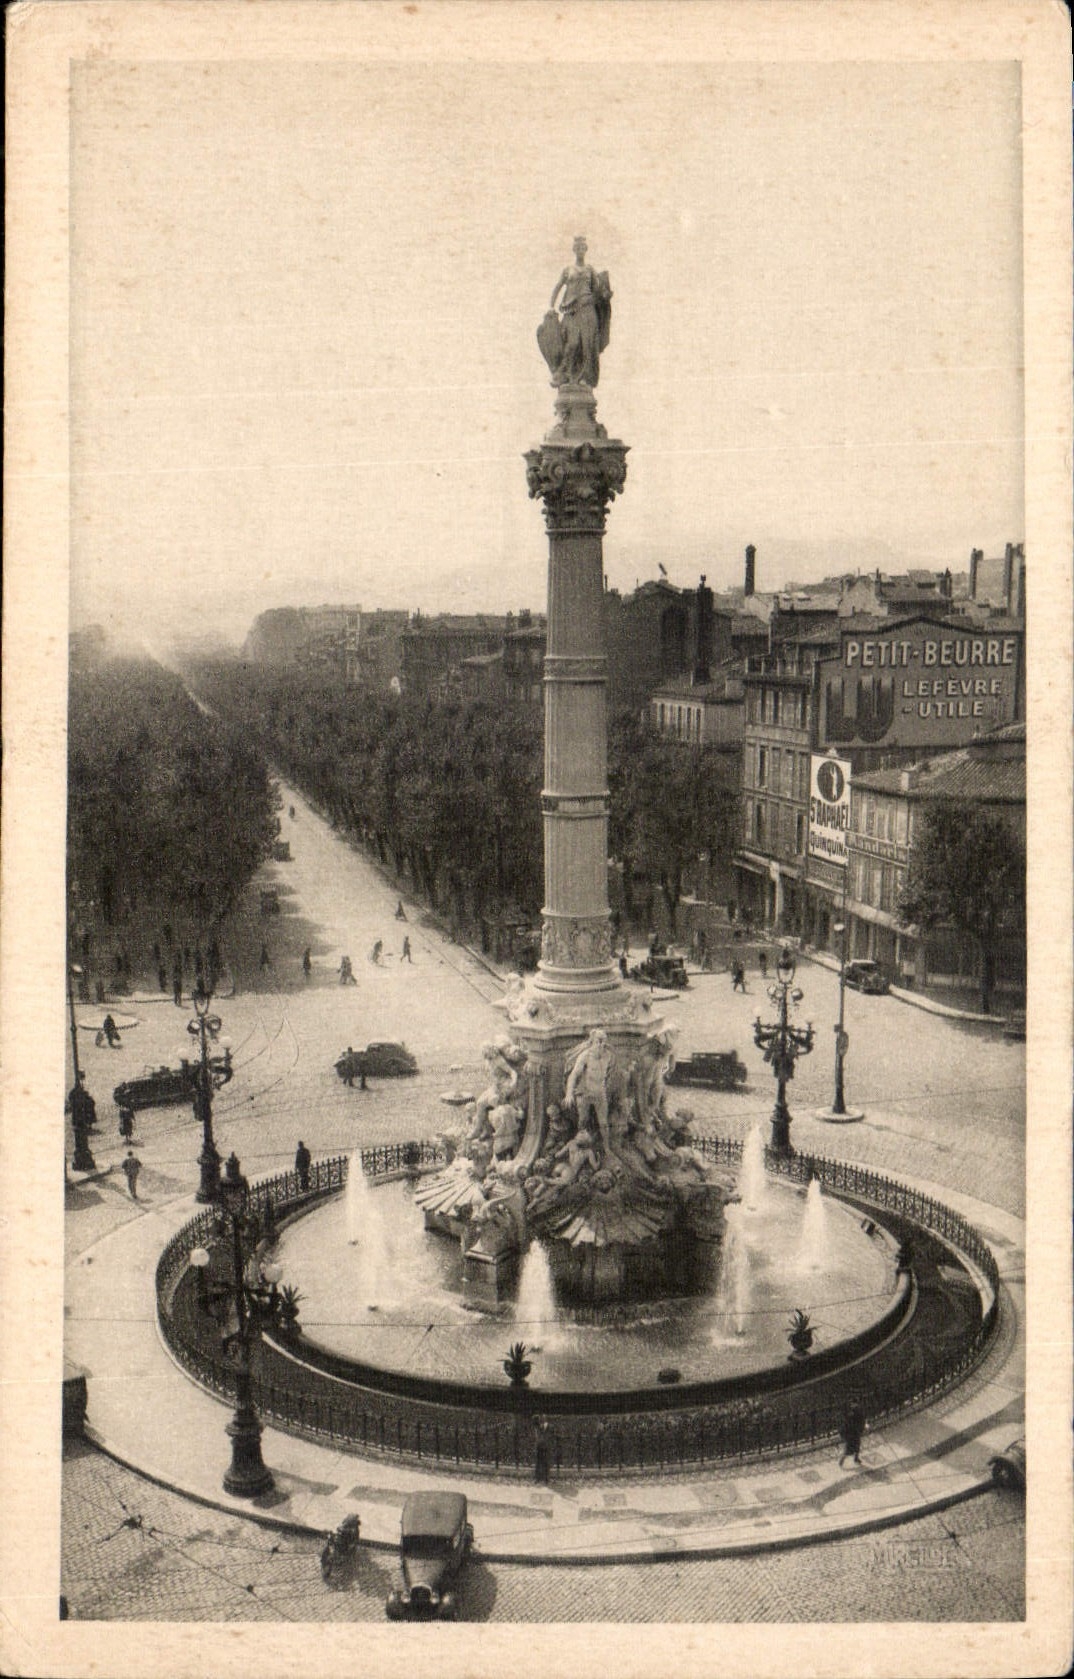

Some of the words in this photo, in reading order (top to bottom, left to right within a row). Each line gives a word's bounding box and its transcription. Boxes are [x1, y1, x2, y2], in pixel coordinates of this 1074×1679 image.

[845, 639, 1016, 668] PETIT-BEURRE
[902, 676, 1002, 697] LEFÈVRE
[820, 673, 895, 743] LU
